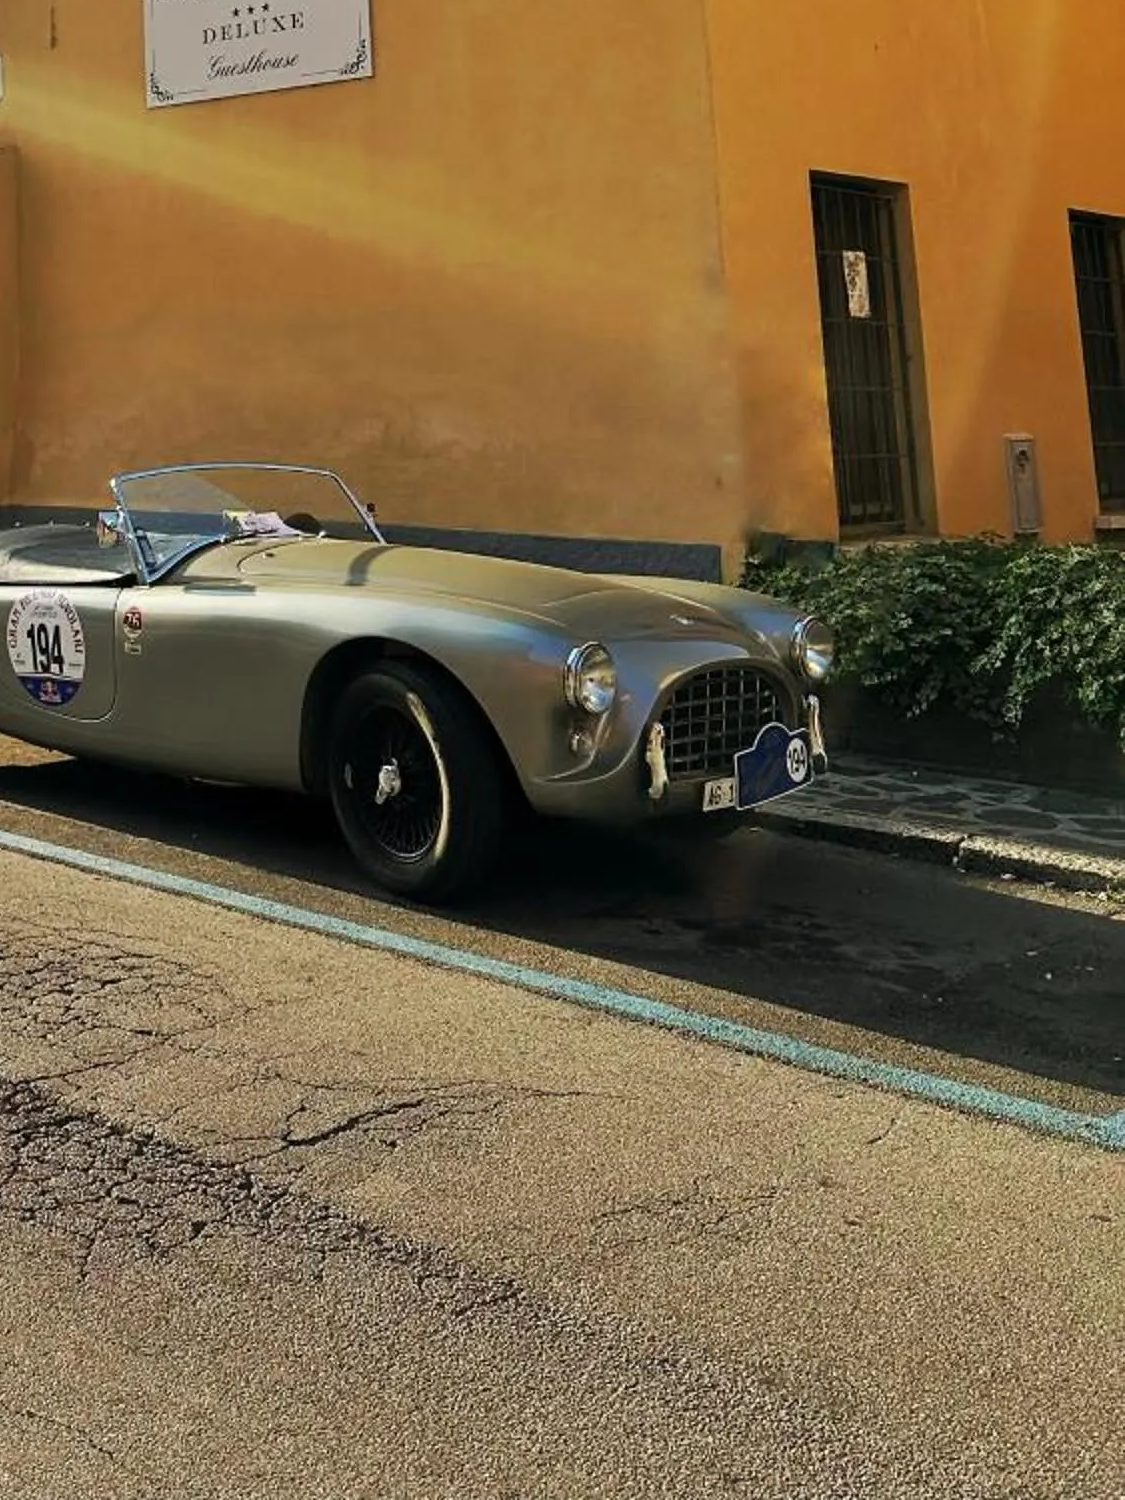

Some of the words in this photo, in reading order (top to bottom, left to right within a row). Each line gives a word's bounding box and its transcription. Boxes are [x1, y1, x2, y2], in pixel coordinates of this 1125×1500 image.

[202, 11, 305, 45] DELUXE
[206, 50, 300, 81] Guesthouse
[27, 623, 65, 675] 194
[788, 744, 806, 773] 194
